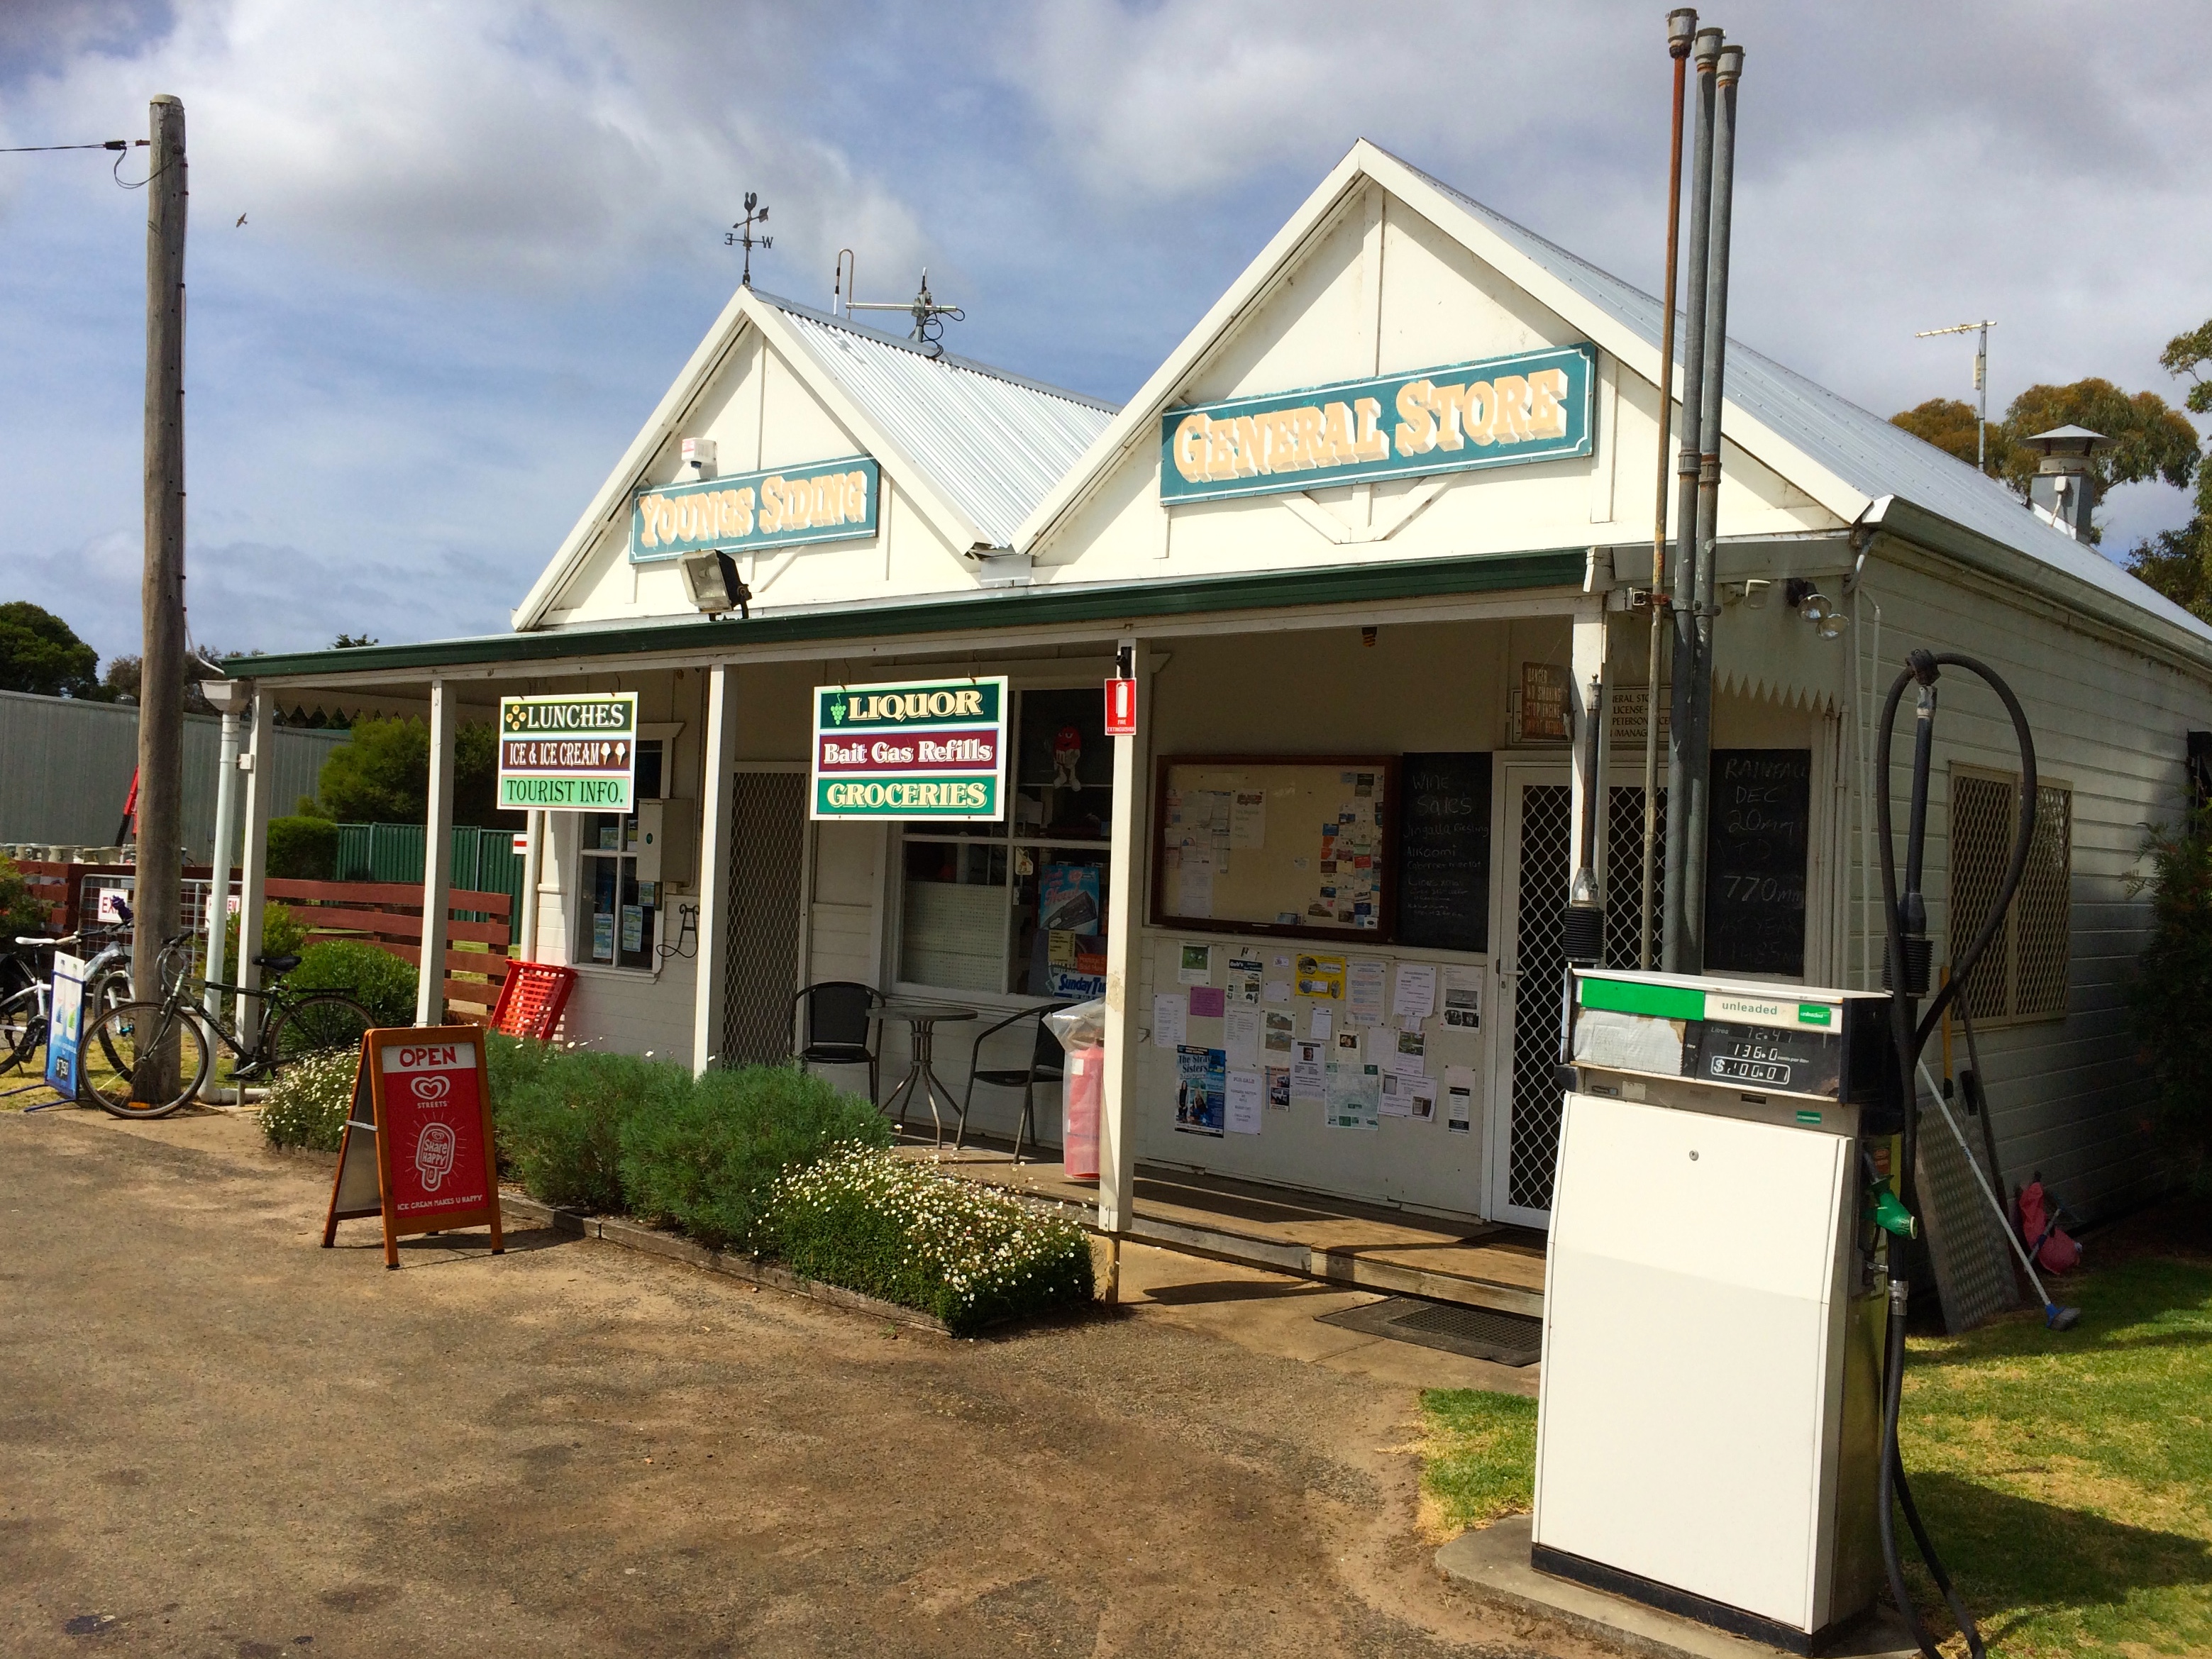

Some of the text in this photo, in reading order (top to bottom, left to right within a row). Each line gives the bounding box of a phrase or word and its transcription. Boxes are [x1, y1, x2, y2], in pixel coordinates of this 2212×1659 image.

[1173, 369, 1568, 484] GENERAL STORE
[639, 470, 868, 548] YOUNGS SIDING
[848, 690, 984, 723] LIQUOR
[1612, 694, 1649, 703] ERAL STO
[527, 704, 625, 728] LUNCHES
[1614, 728, 1648, 738] (MANAG
[509, 742, 599, 767] ICE & ICE CREAM
[824, 738, 993, 765] Bait Gas Refills
[507, 780, 624, 804] TOURIST INFO.
[827, 782, 987, 809] GROCERIES
[1736, 784, 1785, 804] DEC
[1058, 974, 1093, 994] Sunday
[1722, 1001, 1778, 1015] unleaded
[1747, 1026, 1793, 1043] 72.47
[399, 1046, 457, 1067] OPEN
[1178, 1055, 1212, 1064] The Stray
[1183, 1064, 1209, 1074] Sisters
[417, 1101, 448, 1109] STREETS
[411, 1200, 433, 1209] CREAM
[434, 1197, 455, 1206] MAKES
[462, 1194, 482, 1203] HAPPY
